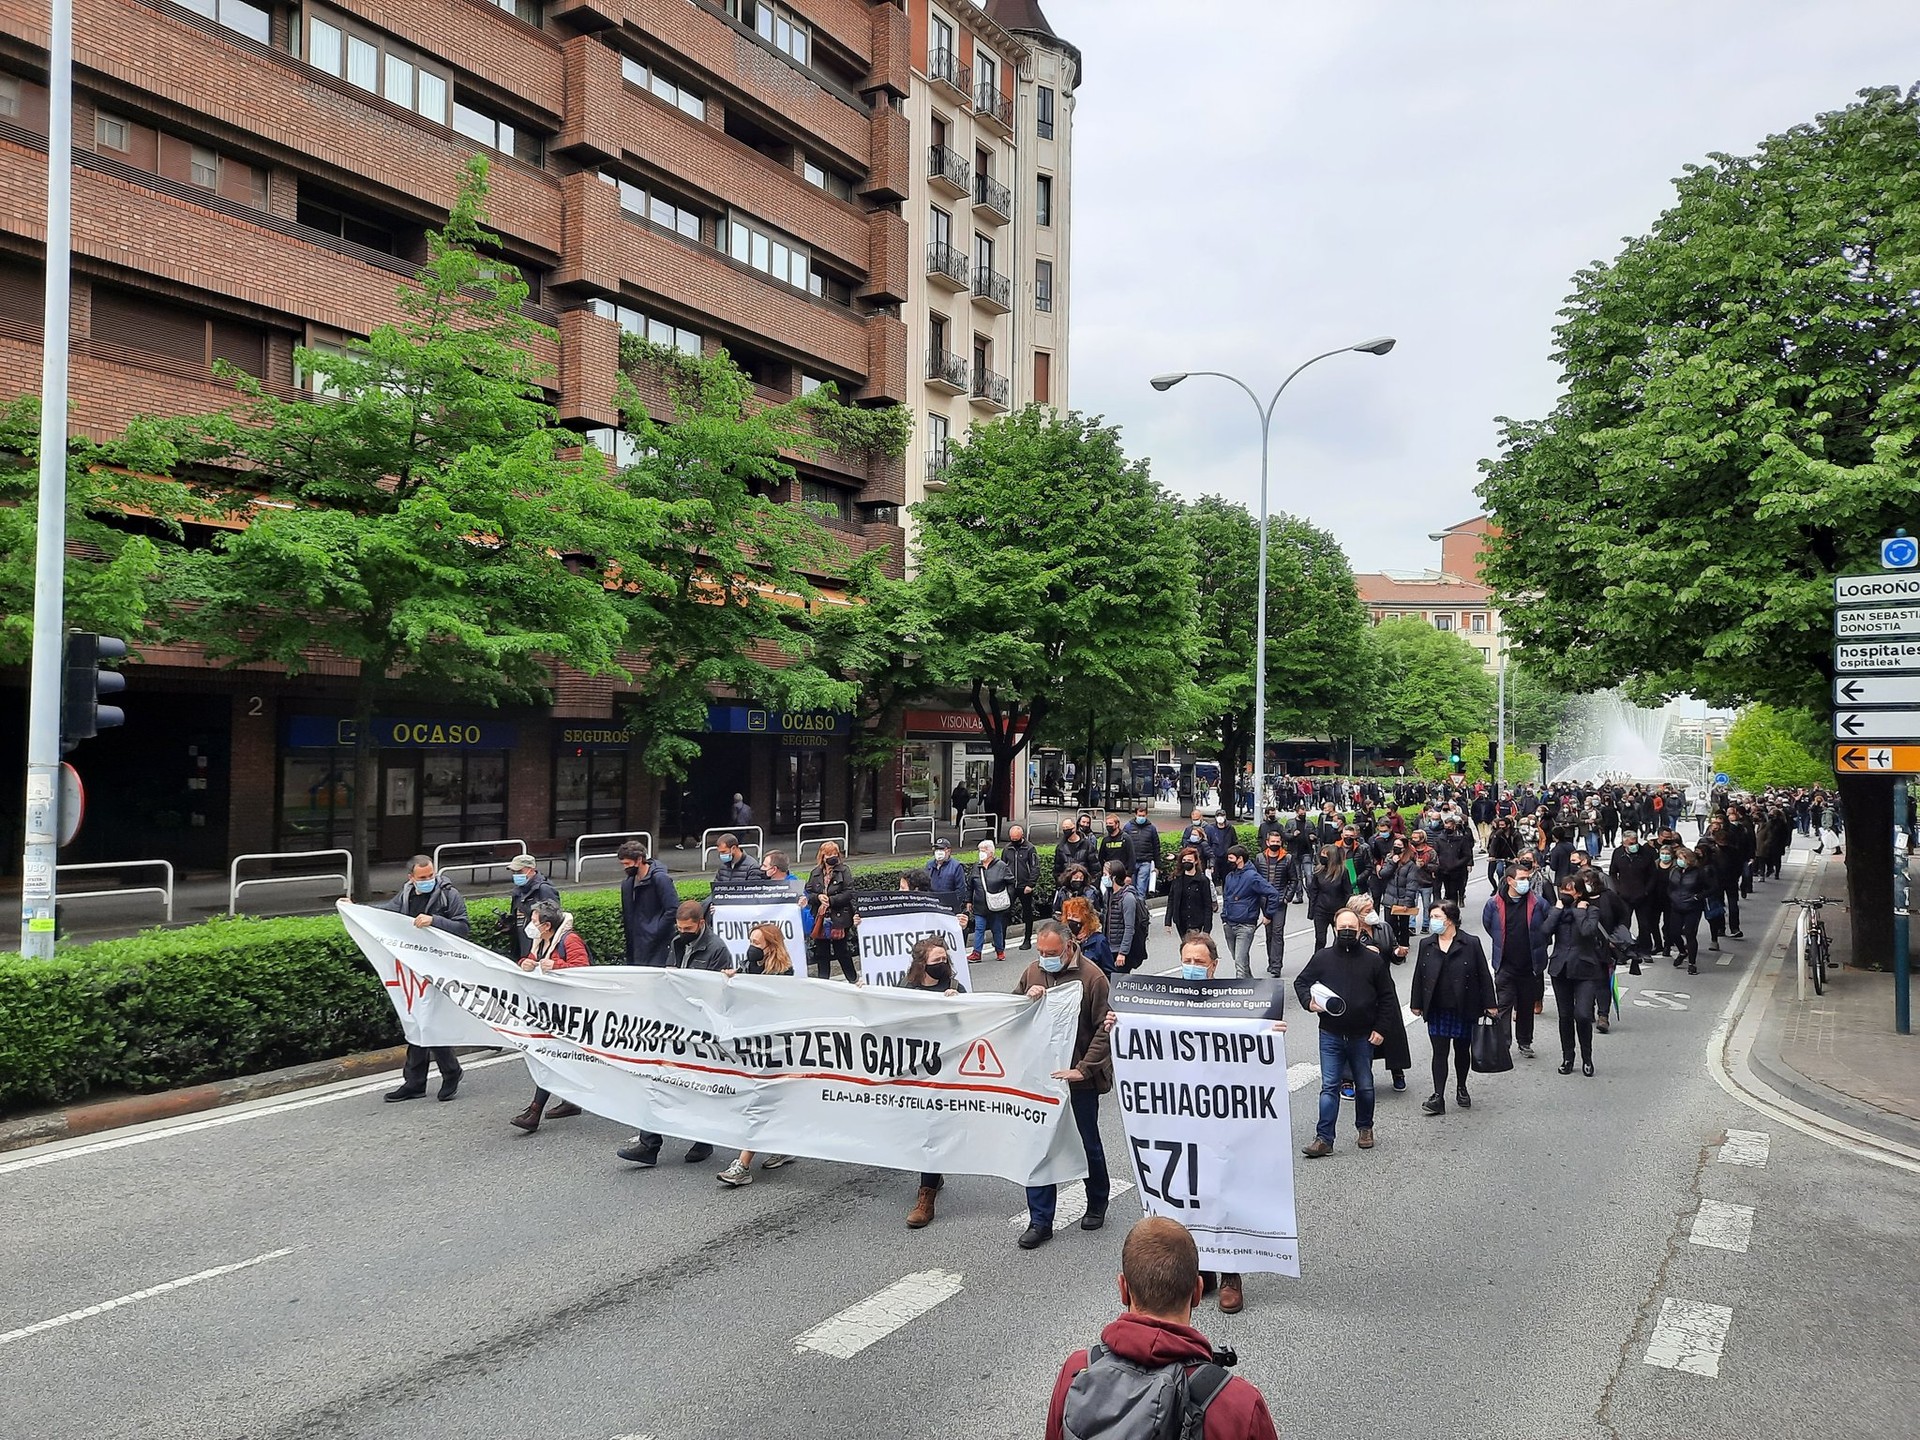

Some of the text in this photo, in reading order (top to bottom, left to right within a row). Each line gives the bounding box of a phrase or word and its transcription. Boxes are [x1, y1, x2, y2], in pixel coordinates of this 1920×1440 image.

[1840, 580, 1920, 597] LOGROÑO
[1841, 611, 1920, 622] SAN SEBASTI
[1840, 623, 1901, 632] DONOSTIA
[1840, 658, 1901, 668] ospitaleak
[248, 696, 263, 716] 2
[782, 713, 835, 730] OCASO
[393, 723, 481, 744] OCASO
[564, 729, 630, 743] SEGUROS
[400, 941, 428, 952] Laneko
[1116, 981, 1254, 997] APIRILAK 28 Laneko Segurtasun
[1114, 995, 1272, 1009] eta Osasunaren Nazioarteko Eguna
[860, 1032, 942, 1077] GAITU
[1115, 1027, 1275, 1065] LAN ISTRIPU
[822, 1089, 1047, 1125] ELA-LAB-ESK-STEILAS-EHNE-HIRU-CGT
[1120, 1080, 1278, 1119] GEHIAGORIK
[1130, 1135, 1200, 1209] EZ!
